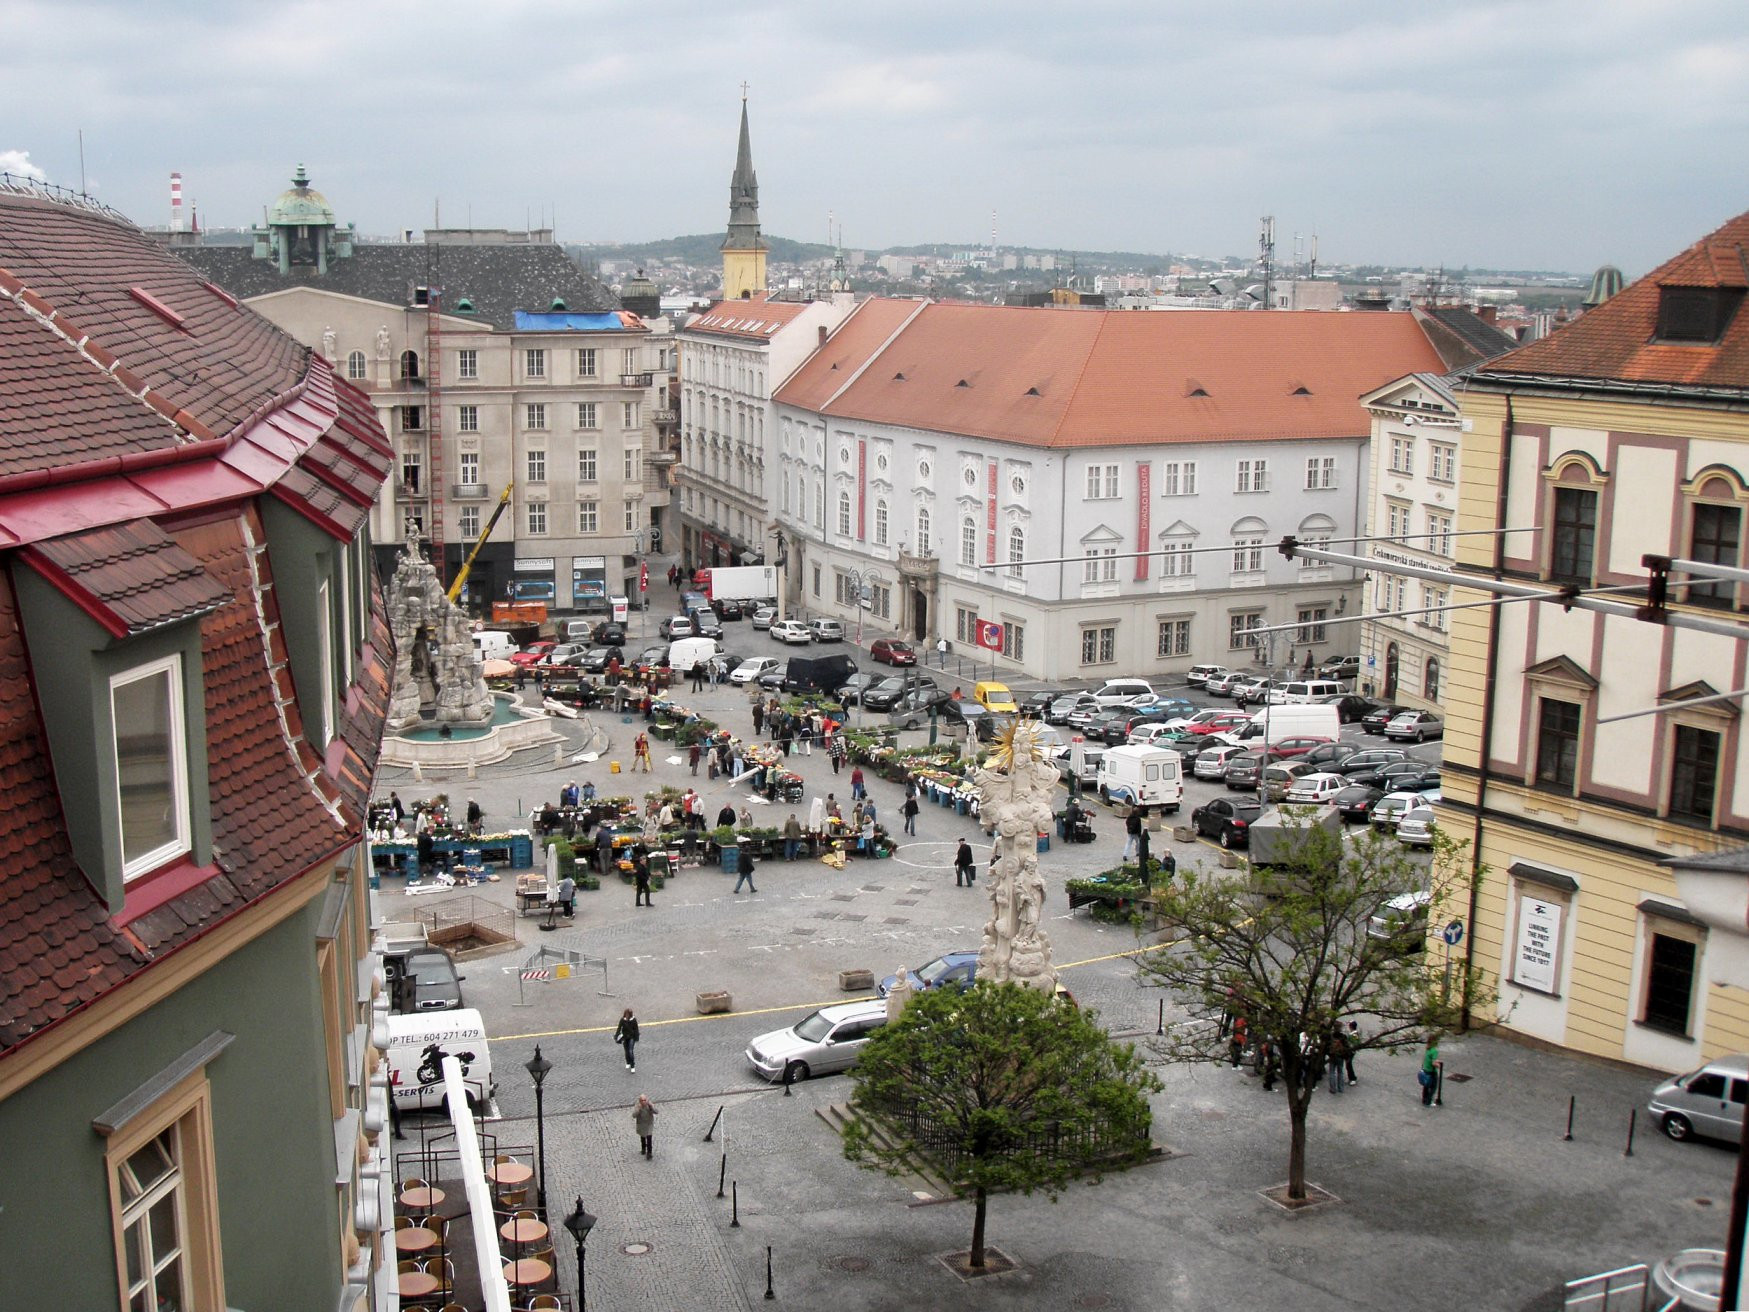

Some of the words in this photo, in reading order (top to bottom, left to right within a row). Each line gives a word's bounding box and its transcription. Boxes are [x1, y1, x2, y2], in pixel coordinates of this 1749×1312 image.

[1373, 544, 1408, 565] Českomoravská
[1528, 923, 1549, 933] LINKING
[1527, 930, 1537, 938] THE
[1537, 933, 1550, 941] PAST
[1531, 940, 1544, 948] WITH
[1523, 945, 1532, 953] THE
[1532, 948, 1551, 959] FUTURE
[1522, 953, 1536, 963] SINCE
[424, 1032, 440, 1042] 604
[443, 1031, 459, 1040] 271
[461, 1029, 479, 1038] 479
